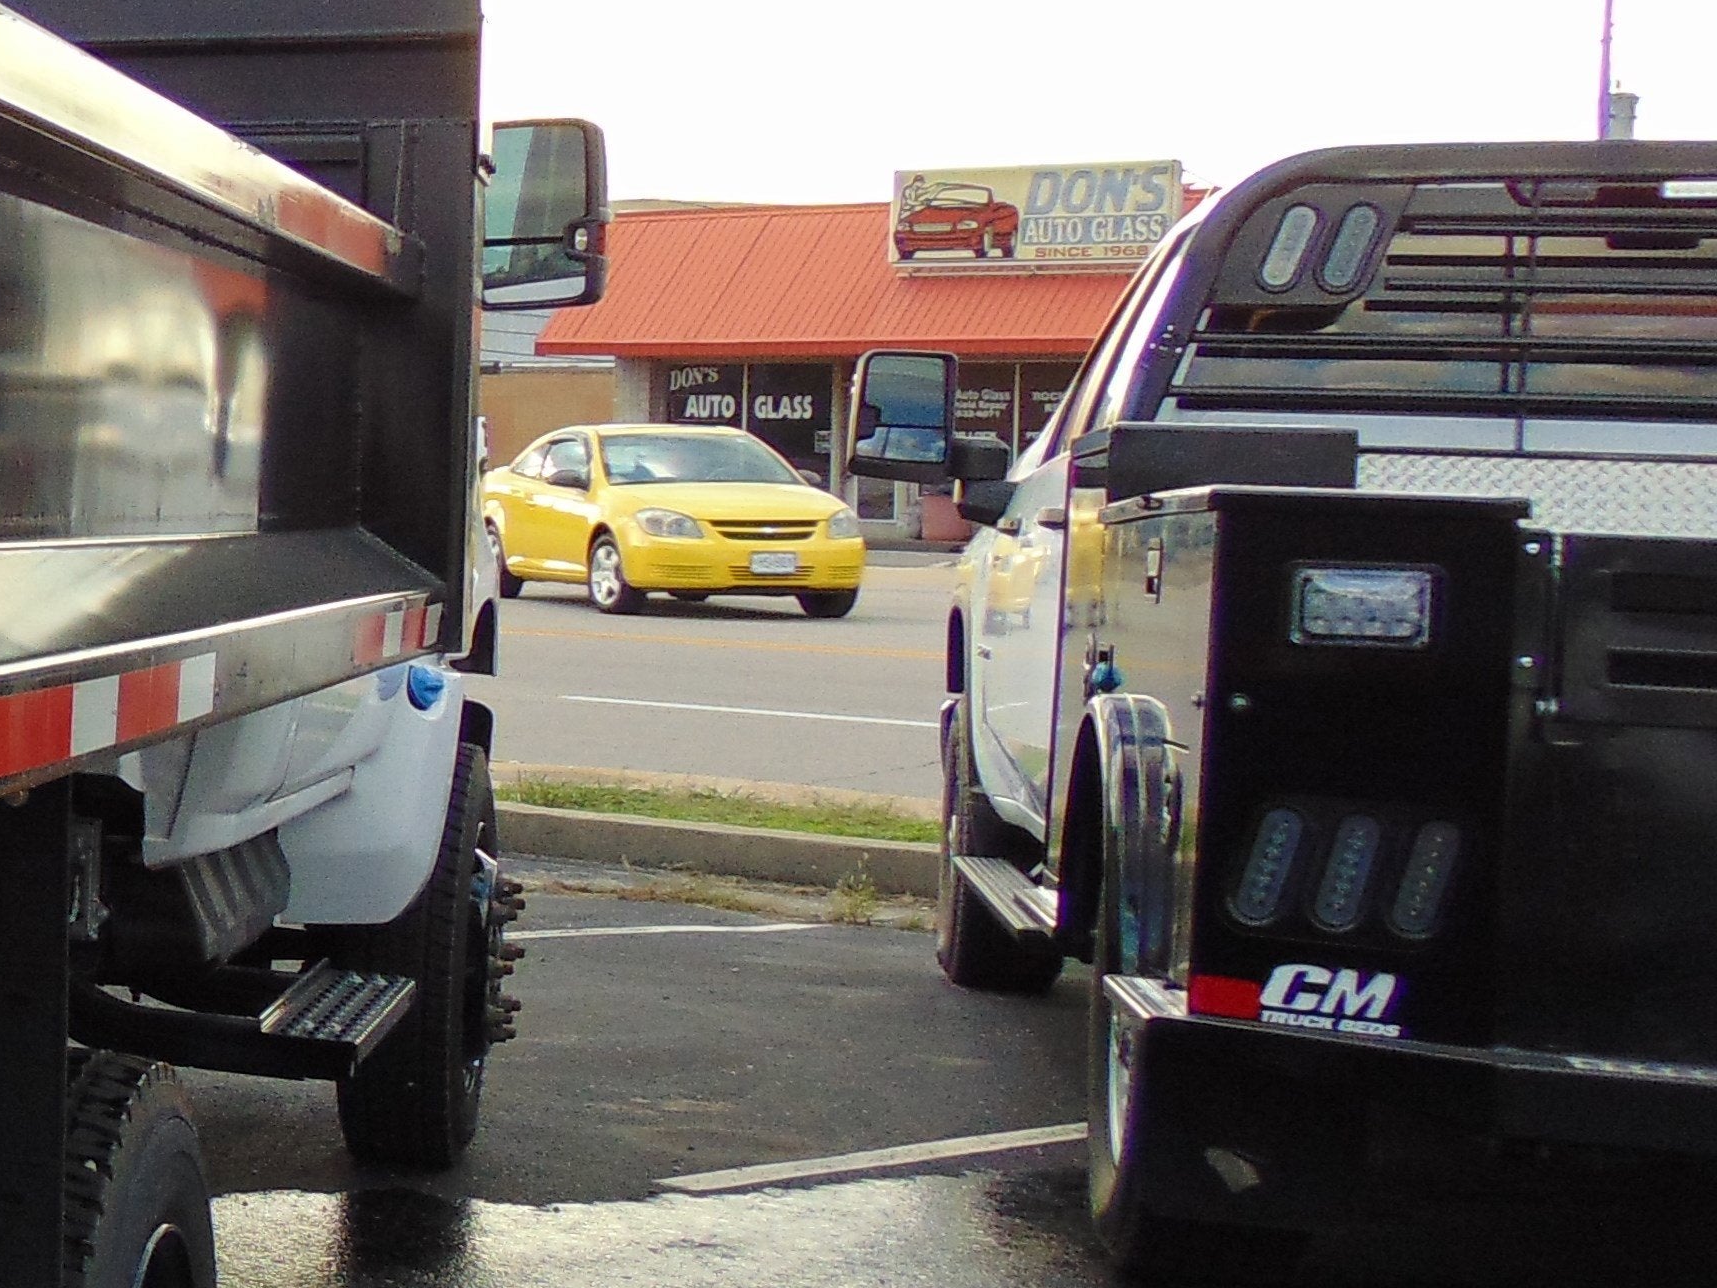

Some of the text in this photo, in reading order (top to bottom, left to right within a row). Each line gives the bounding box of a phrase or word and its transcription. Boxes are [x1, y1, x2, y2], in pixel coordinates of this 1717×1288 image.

[1024, 166, 1171, 215] DON'S
[1024, 215, 1165, 244] AUTO GLASS
[1034, 245, 1149, 258] SINCE 1968
[670, 366, 720, 391] DON'S
[684, 394, 813, 419] AUTO GLASS
[1260, 963, 1397, 1019] CM
[1261, 1010, 1402, 1038] TRUCK BEDS
